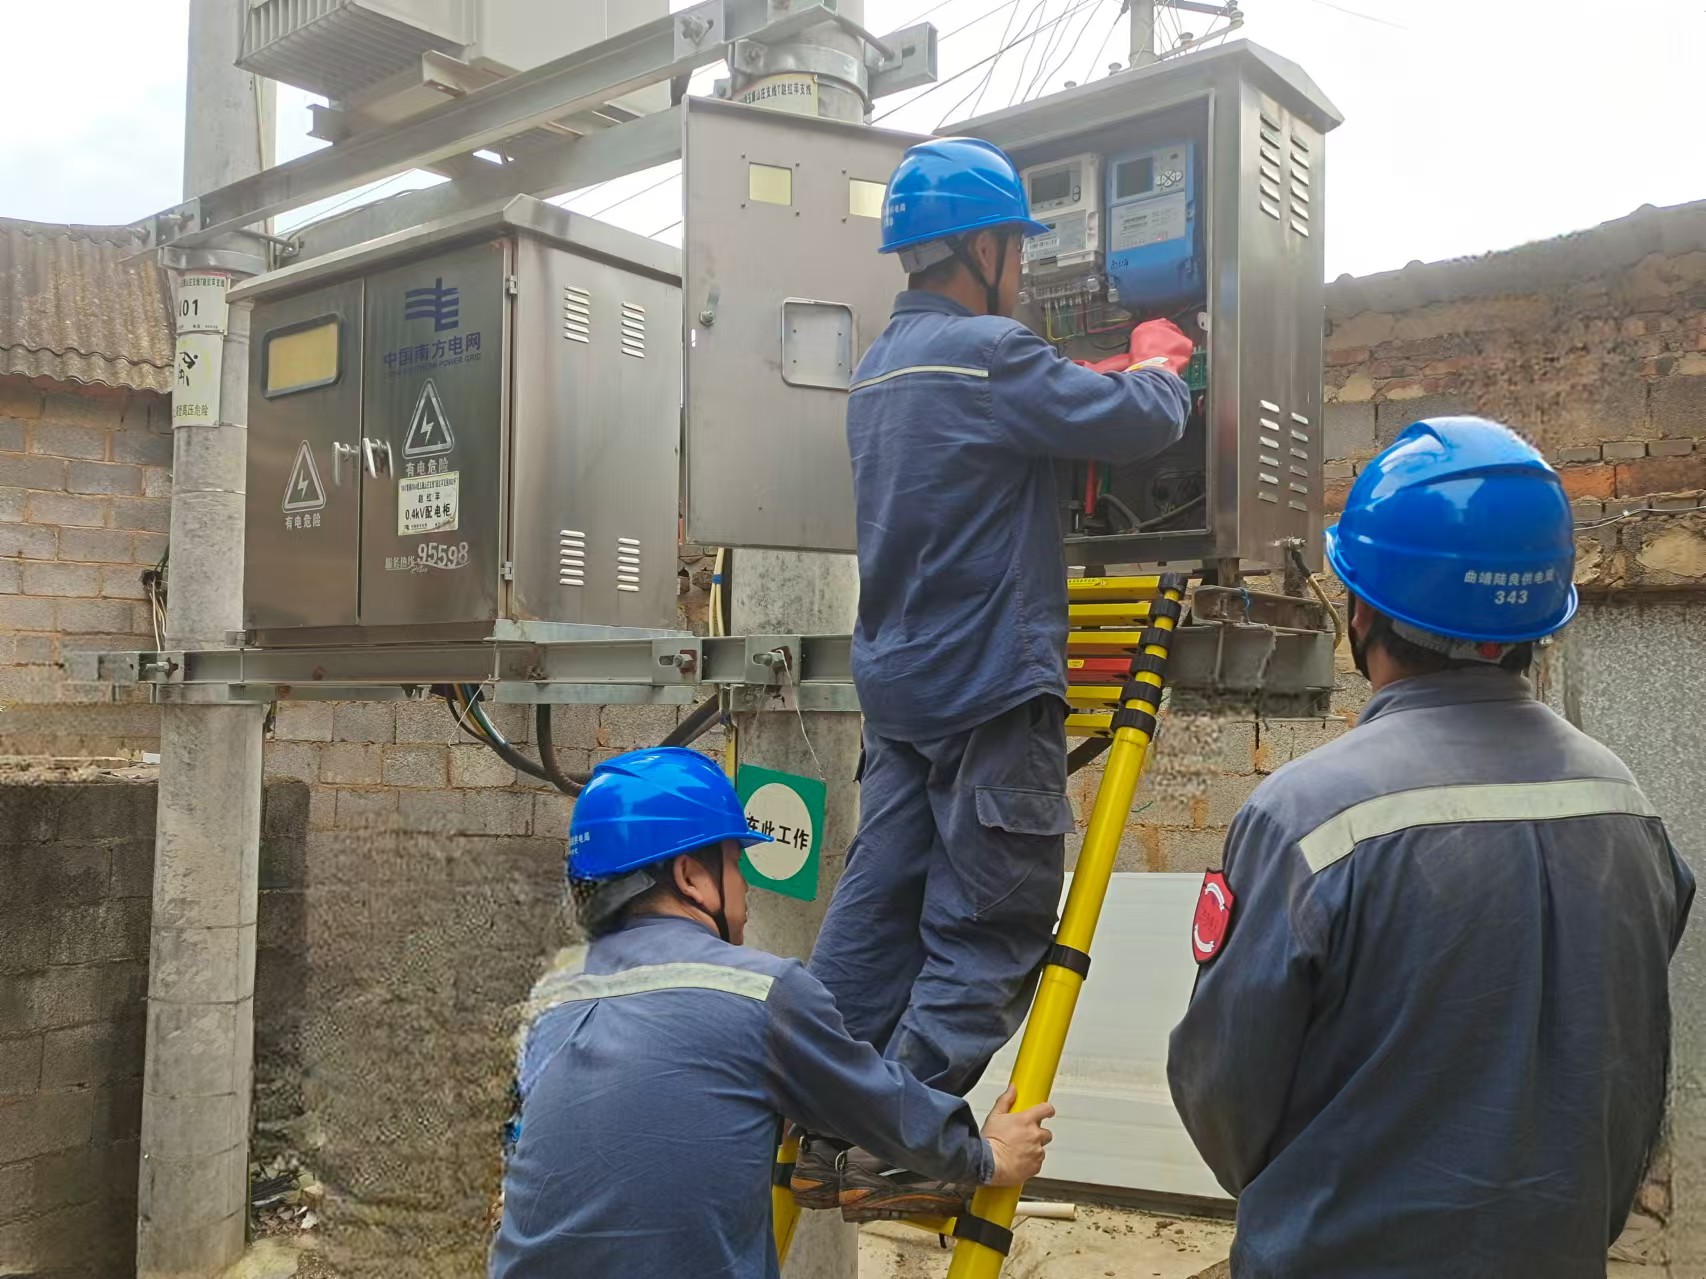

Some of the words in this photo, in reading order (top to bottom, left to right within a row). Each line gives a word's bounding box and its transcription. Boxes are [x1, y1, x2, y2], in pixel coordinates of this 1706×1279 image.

[384, 332, 481, 368] 中国南方电网
[405, 457, 449, 477] 有电危险
[285, 512, 321, 530] 有电危险
[405, 503, 452, 520] 0.4kV配电柜
[417, 541, 469, 568] 95598
[1494, 590, 1529, 605] 343
[746, 815, 809, 850] 在此工作
